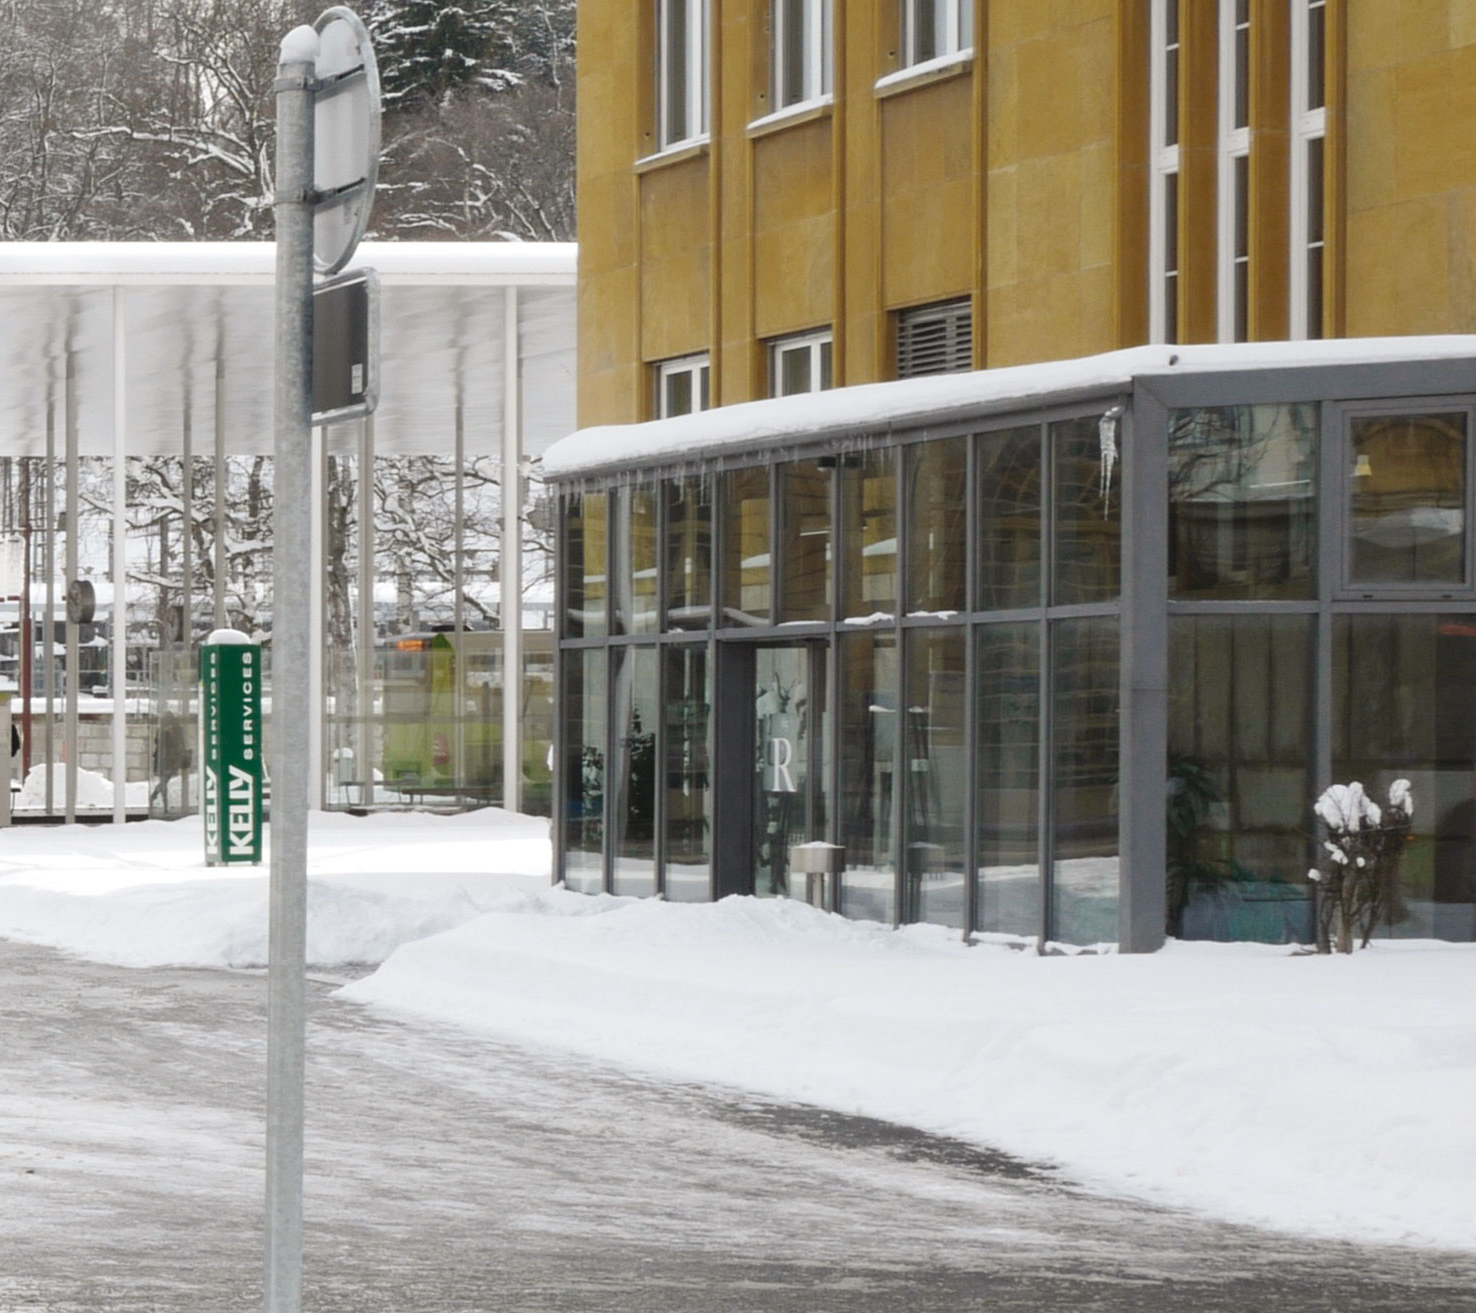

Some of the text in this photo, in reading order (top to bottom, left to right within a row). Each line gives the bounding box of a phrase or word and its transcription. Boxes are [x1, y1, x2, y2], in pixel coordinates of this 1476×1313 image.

[210, 652, 218, 760] SERVICES
[241, 651, 254, 761] SERVICES
[206, 766, 218, 855] KELLY
[229, 764, 254, 856] KELLY
